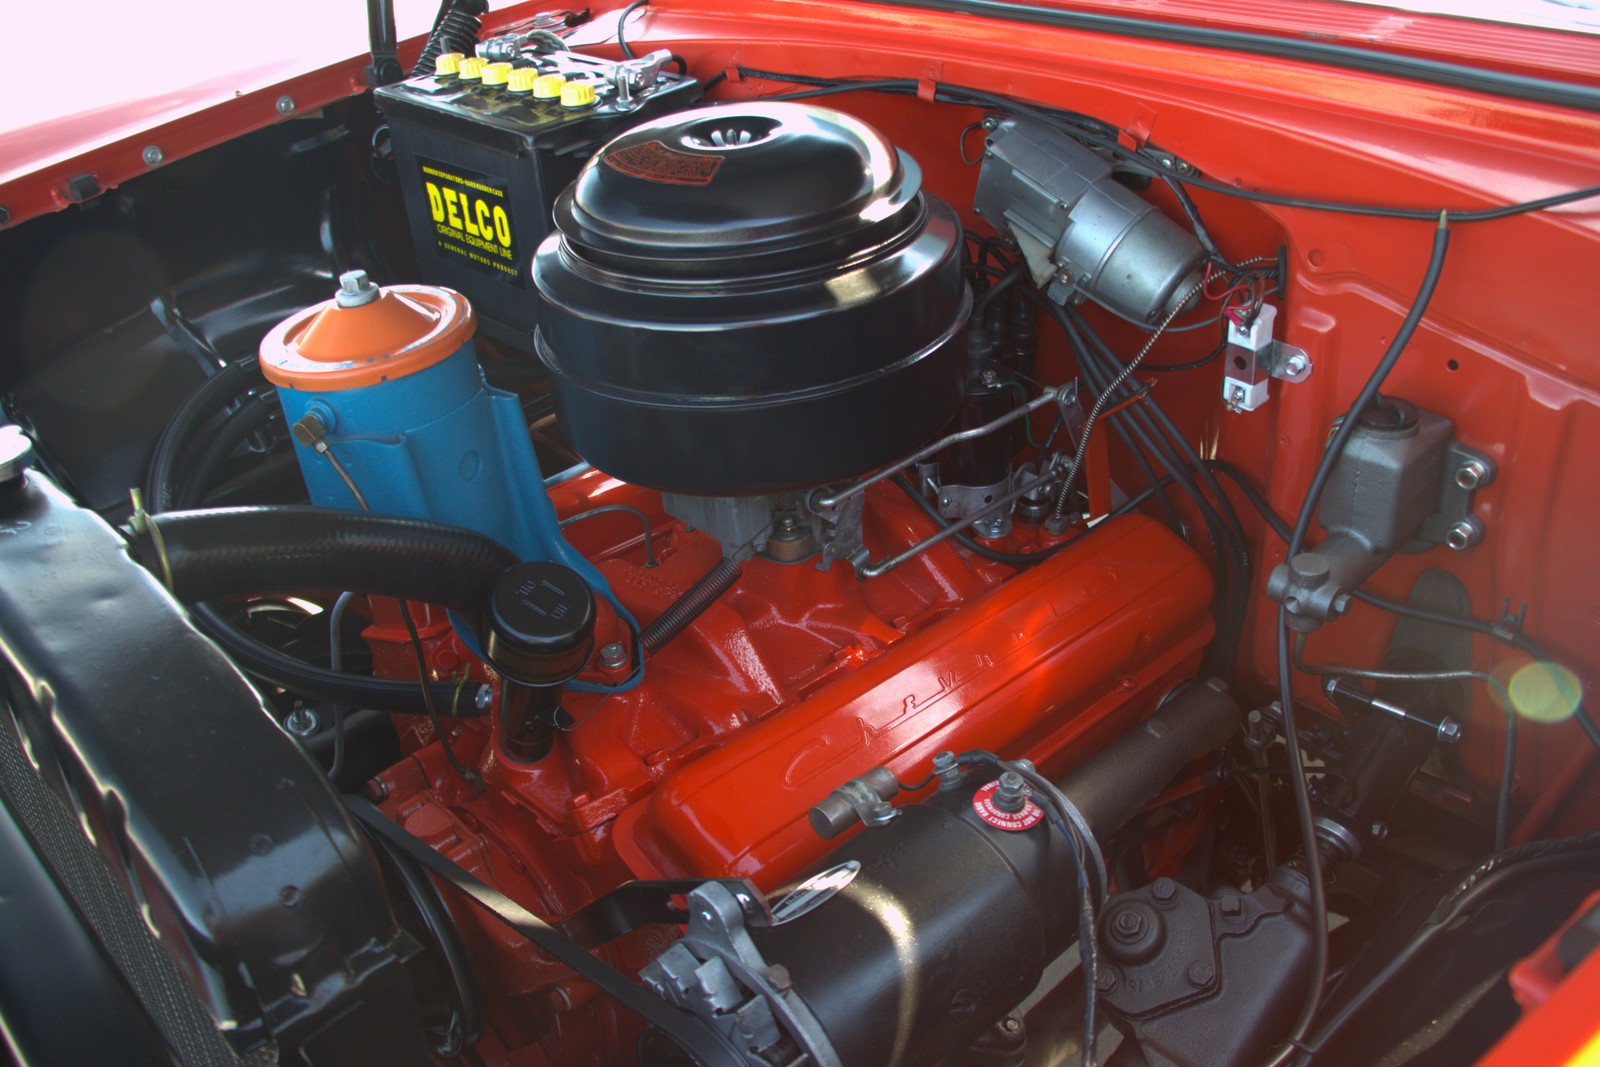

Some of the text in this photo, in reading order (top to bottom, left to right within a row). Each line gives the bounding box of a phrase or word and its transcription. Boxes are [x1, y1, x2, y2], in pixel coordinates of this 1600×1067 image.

[425, 182, 511, 248] DELCO
[437, 223, 513, 260] ORIGINAL EQUIPMENT LINE
[443, 242, 467, 256] GENERAL
[469, 252, 491, 266] MOTORS
[493, 261, 518, 276] PRODUCT
[988, 816, 1022, 828] CONNECT
[1022, 815, 1036, 826] NOT
